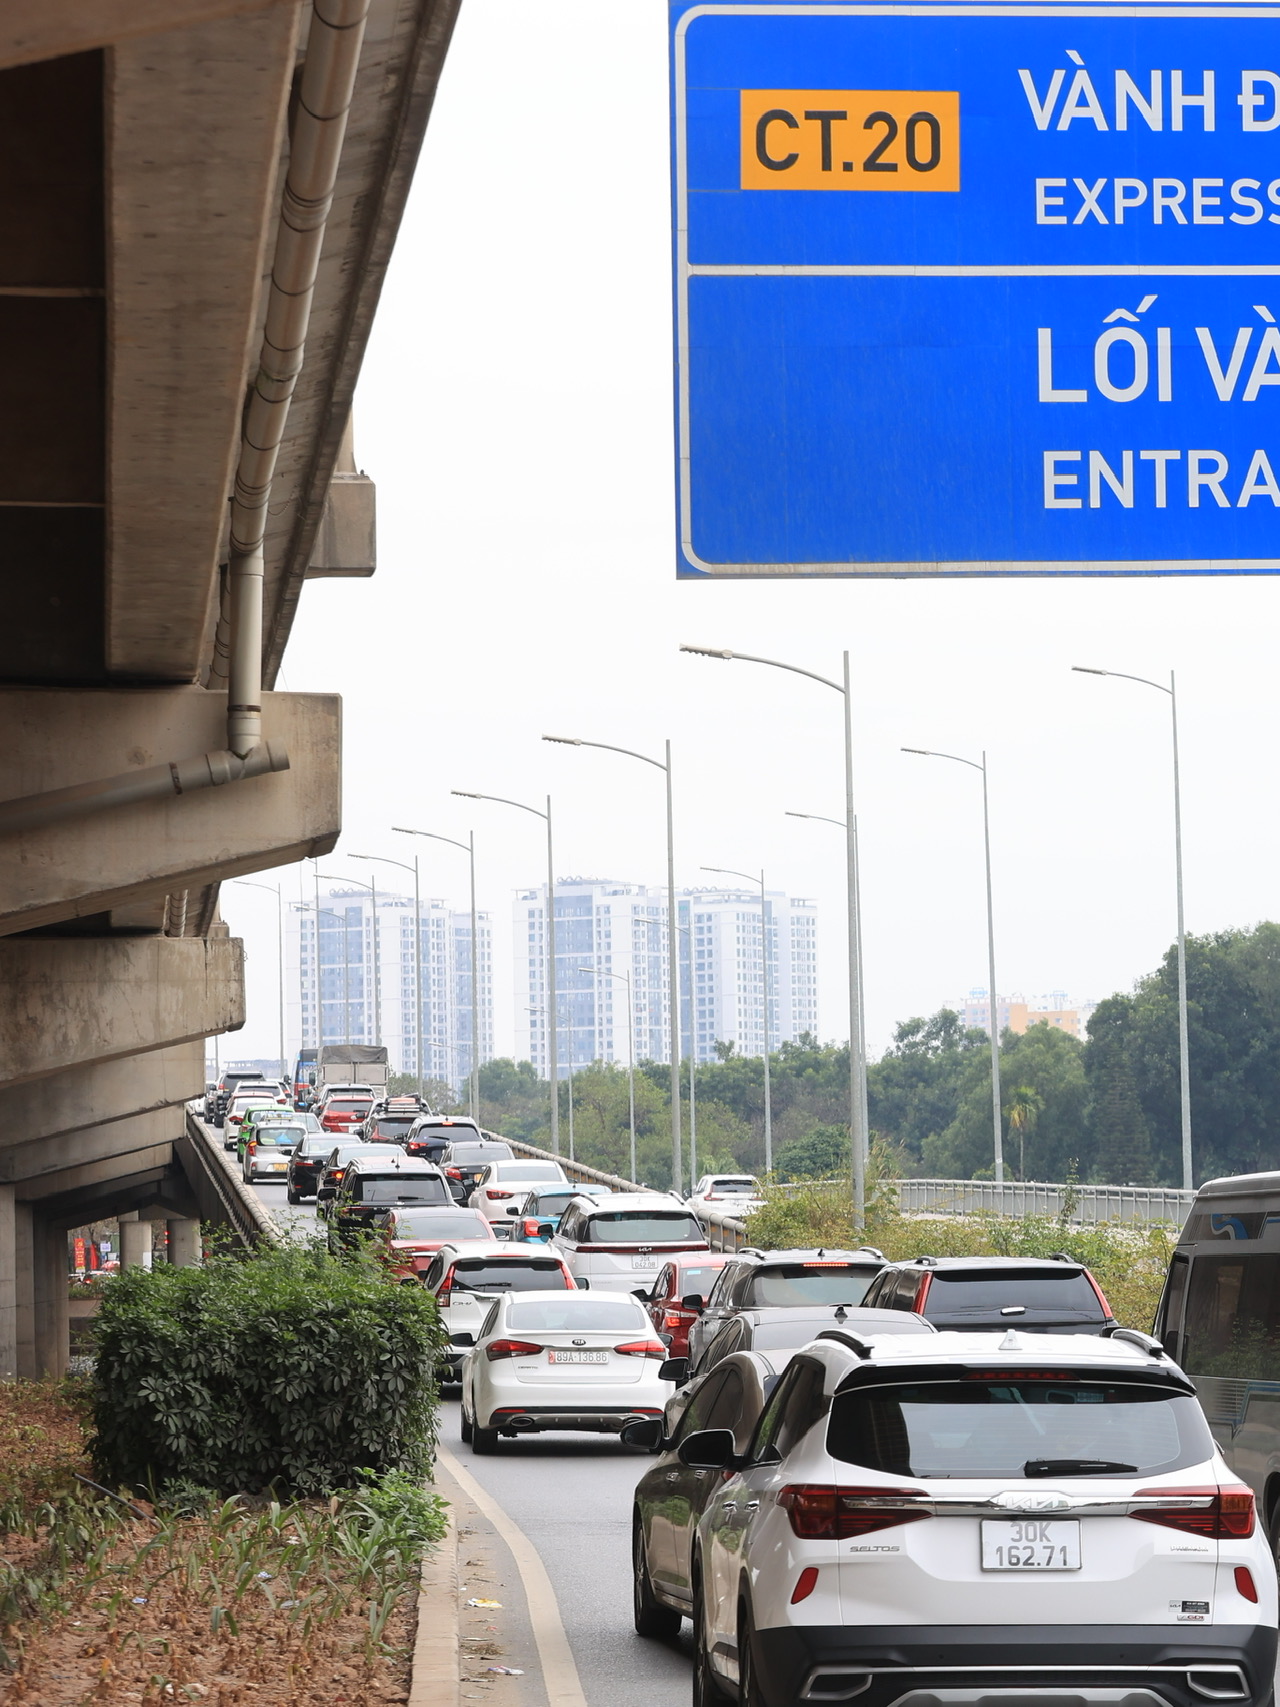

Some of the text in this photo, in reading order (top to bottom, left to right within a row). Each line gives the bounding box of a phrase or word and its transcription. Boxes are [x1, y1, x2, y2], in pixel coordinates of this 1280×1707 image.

[1018, 50, 1216, 132] VÀNH
[755, 109, 941, 173] CT.20
[1038, 294, 1172, 403] LỐI
[849, 1545, 901, 1553] SELTOS
[1009, 1521, 1052, 1543] 30K
[995, 1545, 1068, 1567] 162.71
